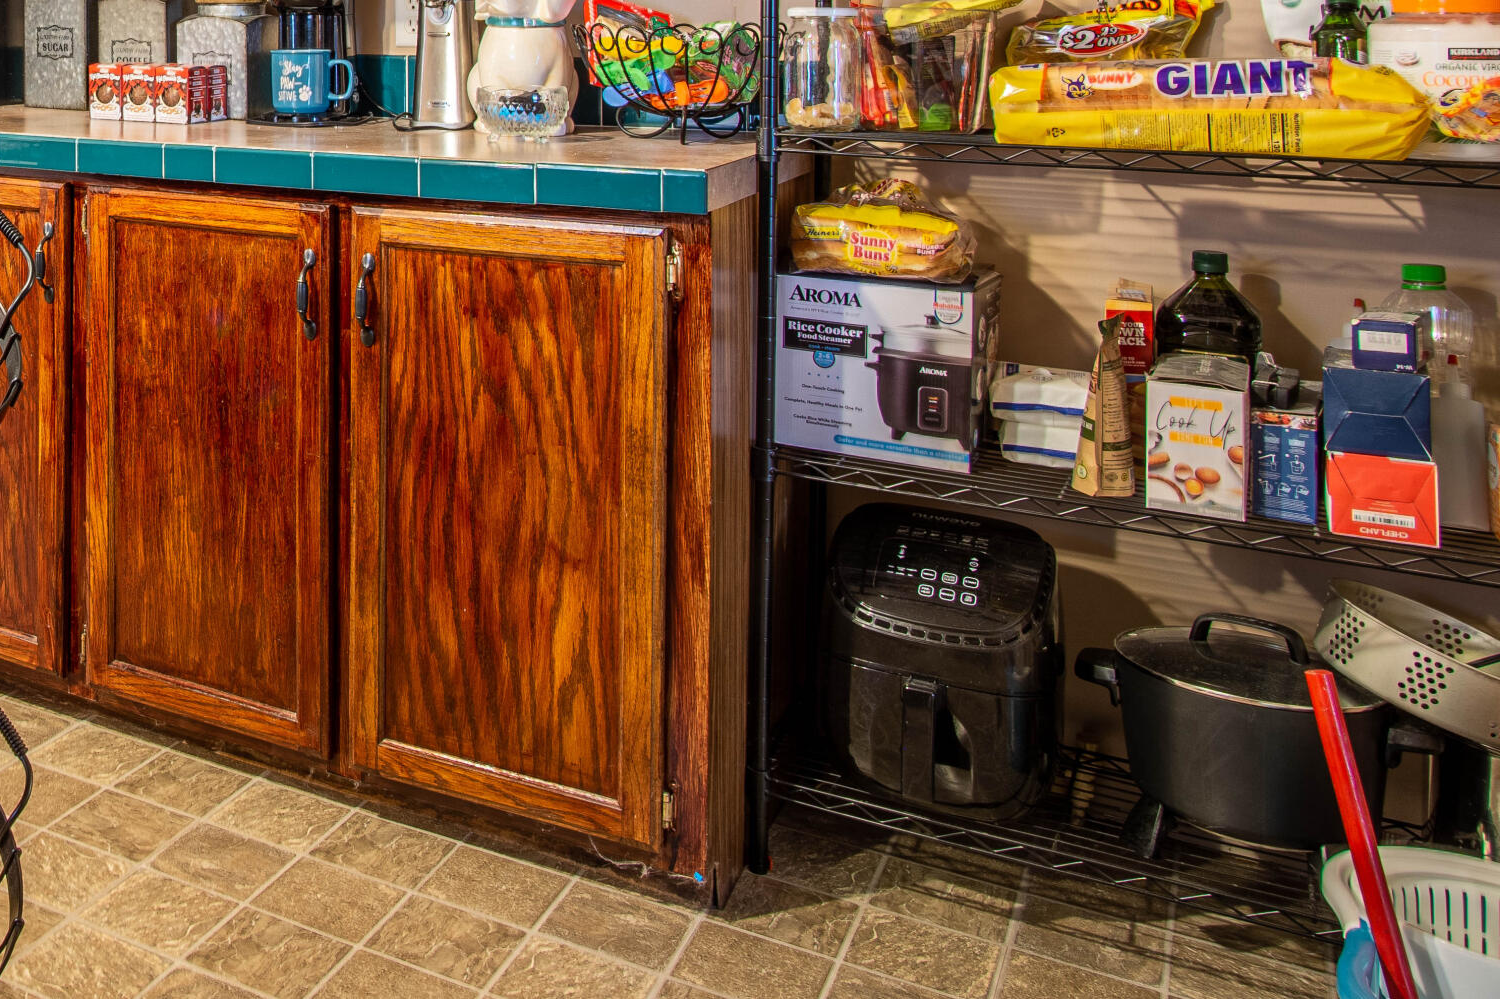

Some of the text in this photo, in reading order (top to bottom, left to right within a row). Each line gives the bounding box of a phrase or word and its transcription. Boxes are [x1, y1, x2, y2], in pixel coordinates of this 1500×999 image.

[42, 42, 69, 52] SUGAR
[1061, 29, 1096, 50] $2
[1097, 33, 1138, 48] ONLY
[279, 58, 309, 78] Stay
[1435, 62, 1478, 72] ORGANIC
[1087, 71, 1136, 86] BUNNY
[1156, 60, 1315, 95] GIANT
[806, 227, 841, 237] Heiner's
[850, 231, 897, 250] Sunny
[853, 246, 890, 262] Buns
[788, 284, 863, 308] AROMA
[788, 320, 864, 338] Rice Cooker
[1123, 320, 1144, 328] YOUR
[797, 331, 853, 344] Food Steamer
[1118, 336, 1147, 347] ACK
[919, 366, 948, 377] AROMA
[1156, 400, 1198, 431] Cook
[1209, 408, 1236, 450] Up
[1359, 526, 1409, 539] CHEFLAND
